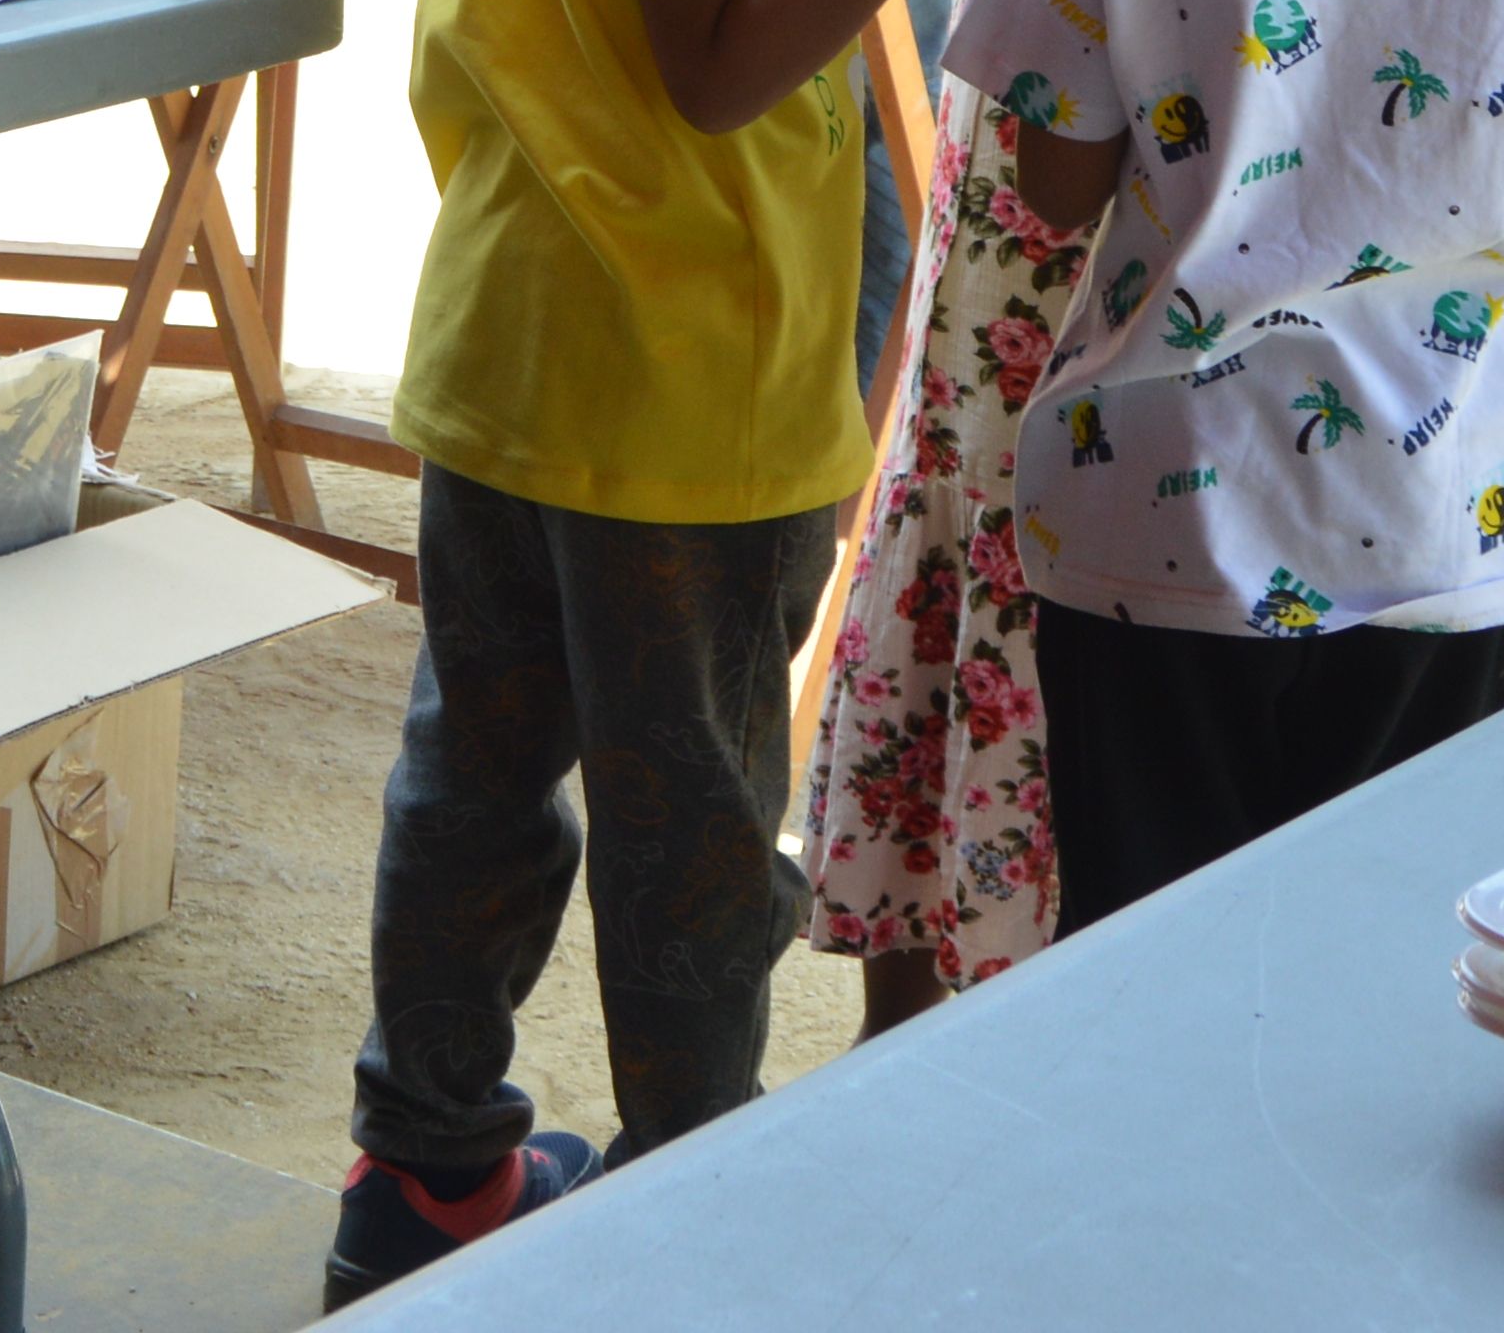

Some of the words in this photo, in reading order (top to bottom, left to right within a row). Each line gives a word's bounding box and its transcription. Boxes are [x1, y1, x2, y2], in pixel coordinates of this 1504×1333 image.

[1239, 147, 1303, 187] WEIRD
[1191, 352, 1246, 389] HEY
[1401, 396, 1455, 456] WEIRD
[1156, 465, 1219, 499] WEIRD
